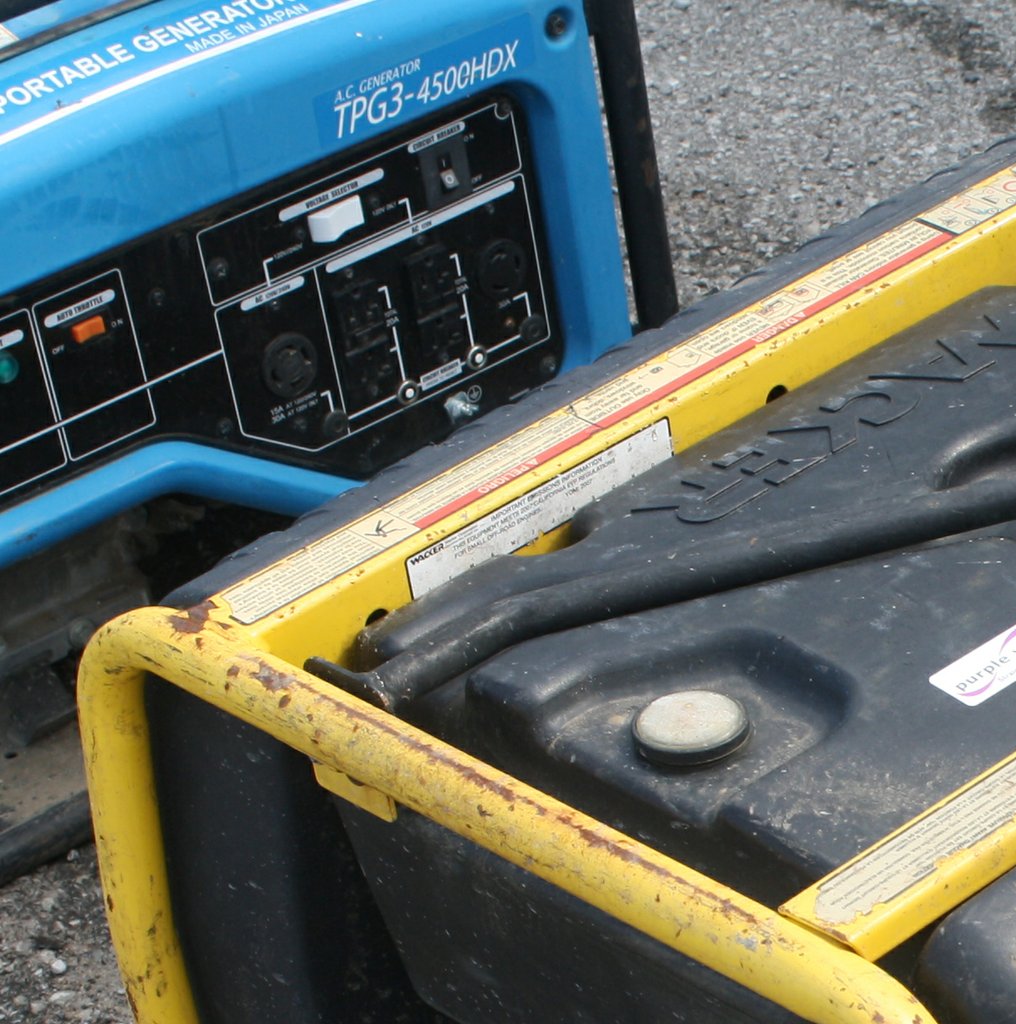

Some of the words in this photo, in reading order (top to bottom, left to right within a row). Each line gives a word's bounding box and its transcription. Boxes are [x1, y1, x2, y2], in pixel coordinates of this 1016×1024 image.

[132, 0, 296, 53] GENERATO
[184, 29, 235, 54] MADE
[238, 21, 256, 36] IN
[258, 3, 309, 28] JAPAN
[333, 39, 519, 139] TPG3-4500HDX
[334, 85, 356, 103] A.C.
[359, 58, 421, 94] GENERATOR
[412, 136, 435, 151] CIRCUIT
[752, 317, 796, 343] DANGER
[477, 463, 530, 494] PELIGRO
[490, 497, 527, 521] IMPORTANT
[561, 456, 603, 482] INFORMATION
[453, 540, 466, 551] THIS
[466, 522, 499, 543] EQUIPMENT
[501, 511, 519, 524] MEETS
[454, 549, 467, 559] FOR
[467, 539, 486, 552] SMALL
[410, 543, 444, 565] WACKER
[955, 653, 1010, 692] purple
